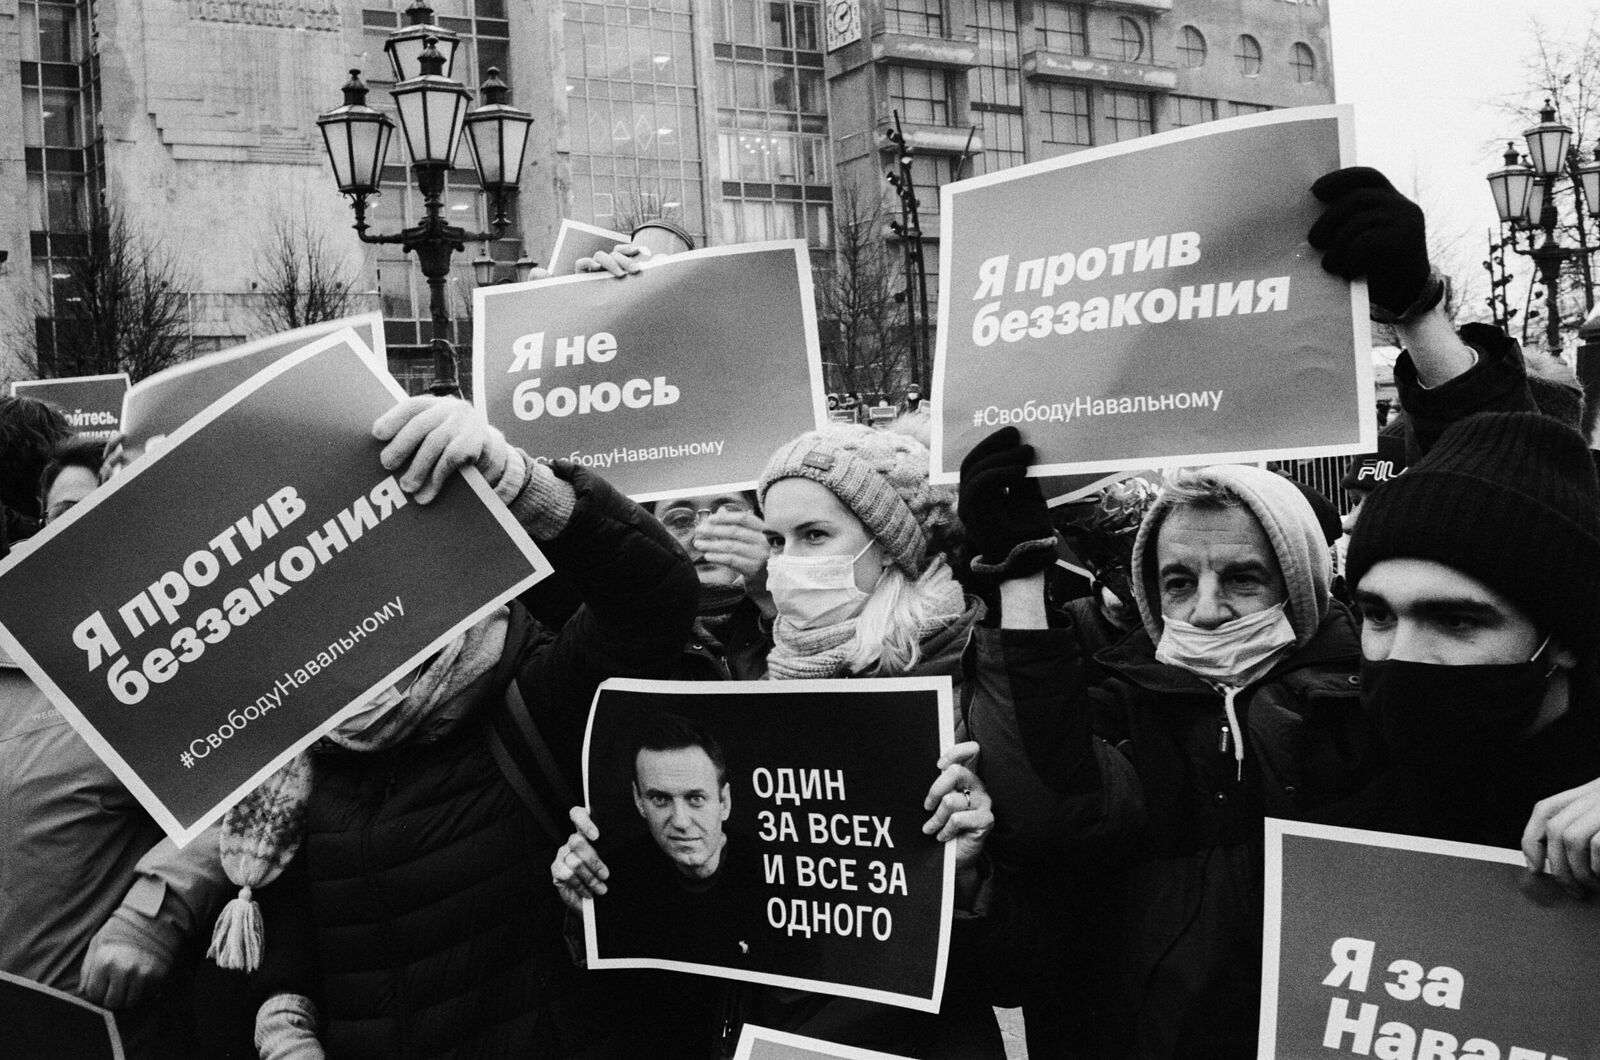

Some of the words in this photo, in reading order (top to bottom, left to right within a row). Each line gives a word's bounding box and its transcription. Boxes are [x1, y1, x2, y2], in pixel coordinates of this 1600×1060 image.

[973, 253, 1010, 300] Я
[1014, 231, 1201, 297] против
[972, 276, 1290, 346] беззакония
[507, 332, 545, 373] Я
[555, 332, 617, 367] не
[512, 376, 681, 421] боюсь
[973, 390, 1223, 426] #СвободуНавальному
[1357, 459, 1409, 481] FIL
[72, 610, 122, 672] Я
[118, 485, 307, 639] против
[106, 475, 408, 705] беззакония
[179, 596, 406, 769] #СвободуНавальному
[752, 767, 846, 806] ОДИН
[757, 810, 799, 843] ЗА
[808, 812, 895, 848] ВСЕХ
[763, 854, 785, 885] И
[796, 855, 858, 891] ВСЕ
[867, 860, 908, 896] ЗА
[767, 896, 893, 942] ОДНОГО
[1321, 936, 1376, 992] Я
[1384, 959, 1465, 1010] за
